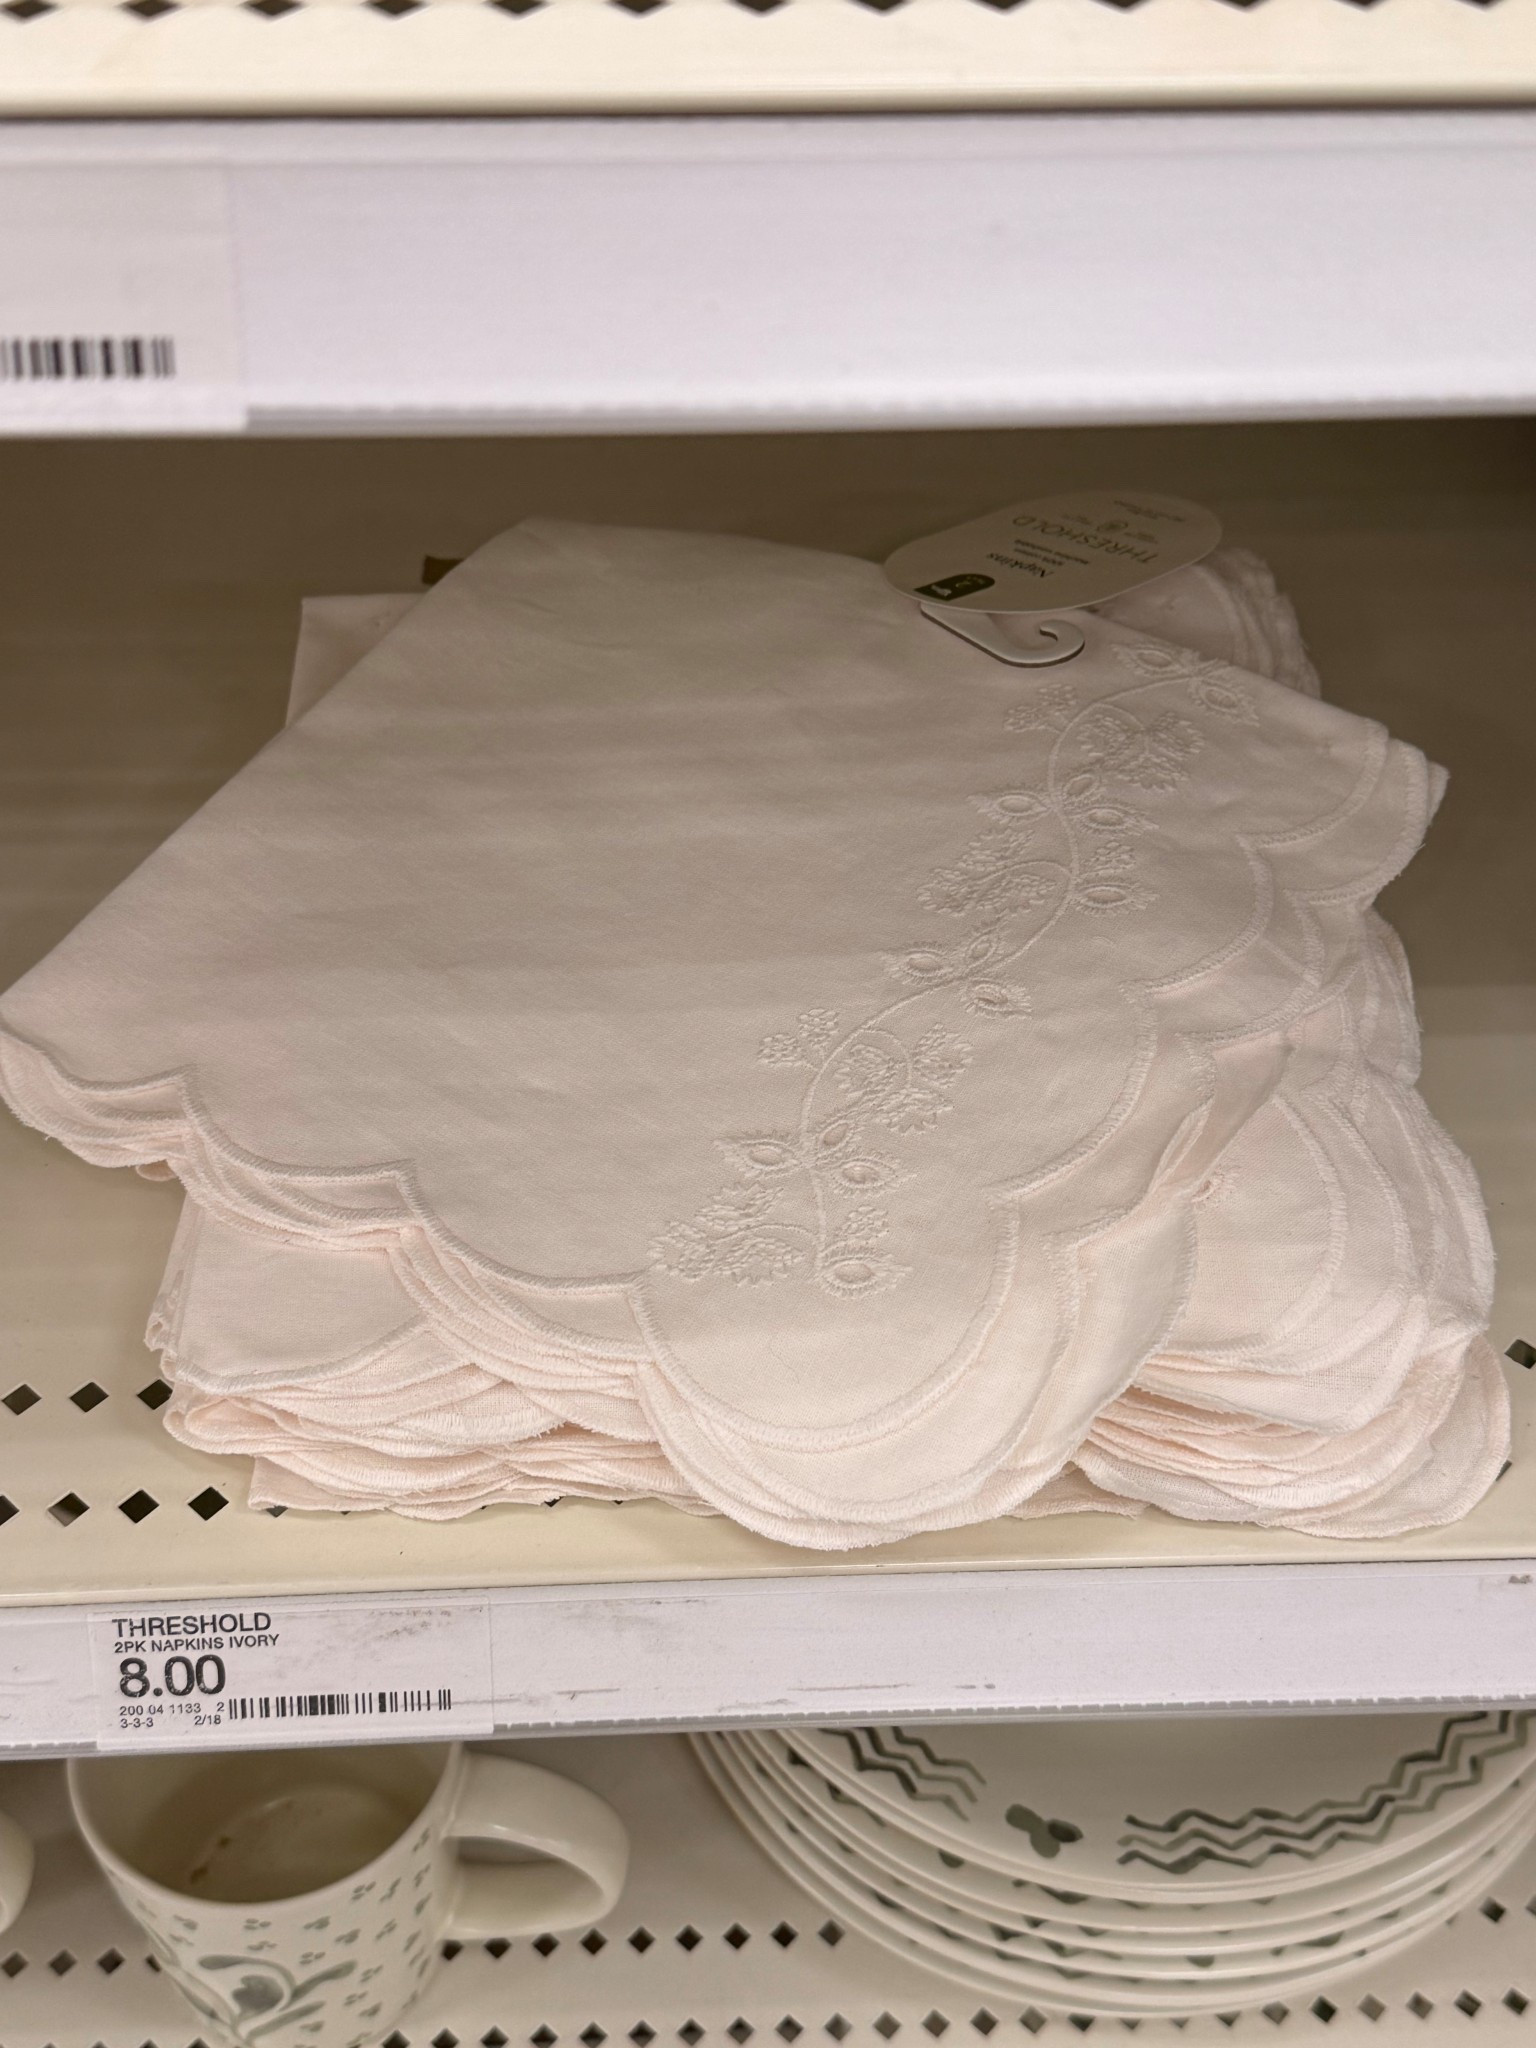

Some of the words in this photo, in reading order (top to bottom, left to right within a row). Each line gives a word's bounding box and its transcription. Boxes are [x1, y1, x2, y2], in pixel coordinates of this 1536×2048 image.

[1012, 515, 1159, 564] THRESHOLD
[112, 1612, 272, 1638] THRESHOLD
[114, 1640, 147, 1654] 2PK
[151, 1637, 225, 1653] NAPKINS
[229, 1633, 280, 1649] IVORY
[119, 1654, 226, 1698] 8.00
[119, 1704, 144, 1717] 200
[148, 1703, 164, 1715] 04
[169, 1702, 202, 1715] 1133
[216, 1701, 225, 1713] 2
[120, 1716, 154, 1729] 3-3-3
[194, 1714, 222, 1726] 2/18
